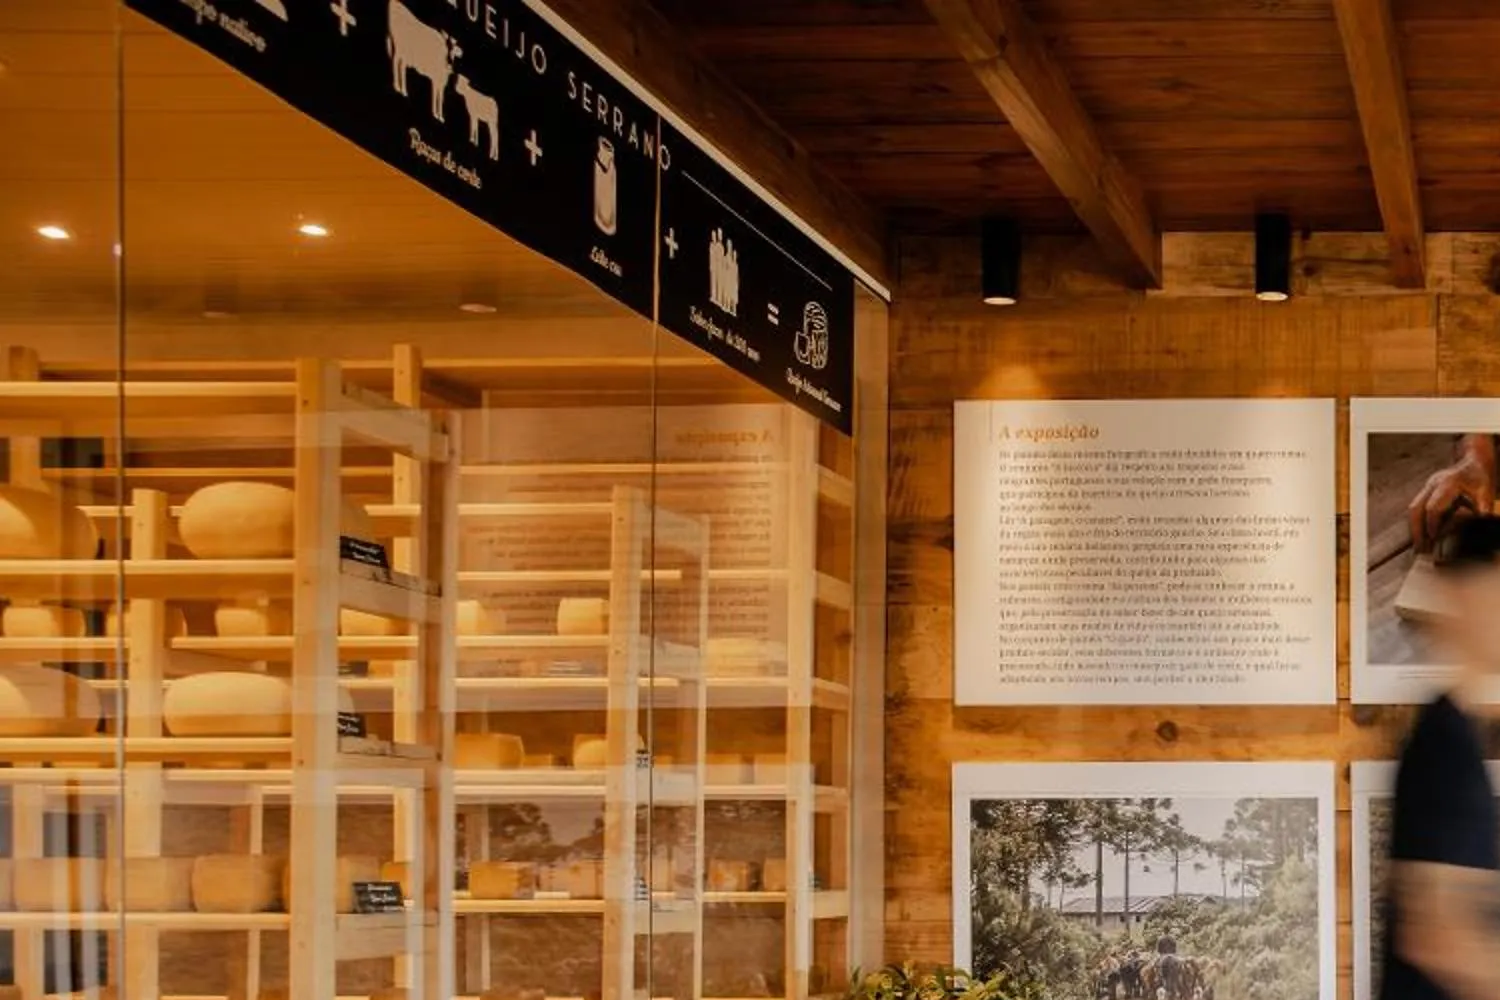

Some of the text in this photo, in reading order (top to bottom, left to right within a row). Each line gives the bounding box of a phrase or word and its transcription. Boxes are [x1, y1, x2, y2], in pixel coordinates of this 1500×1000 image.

[446, 0, 671, 171] UEIJO SERRANO
[999, 424, 1100, 442] A exposição
